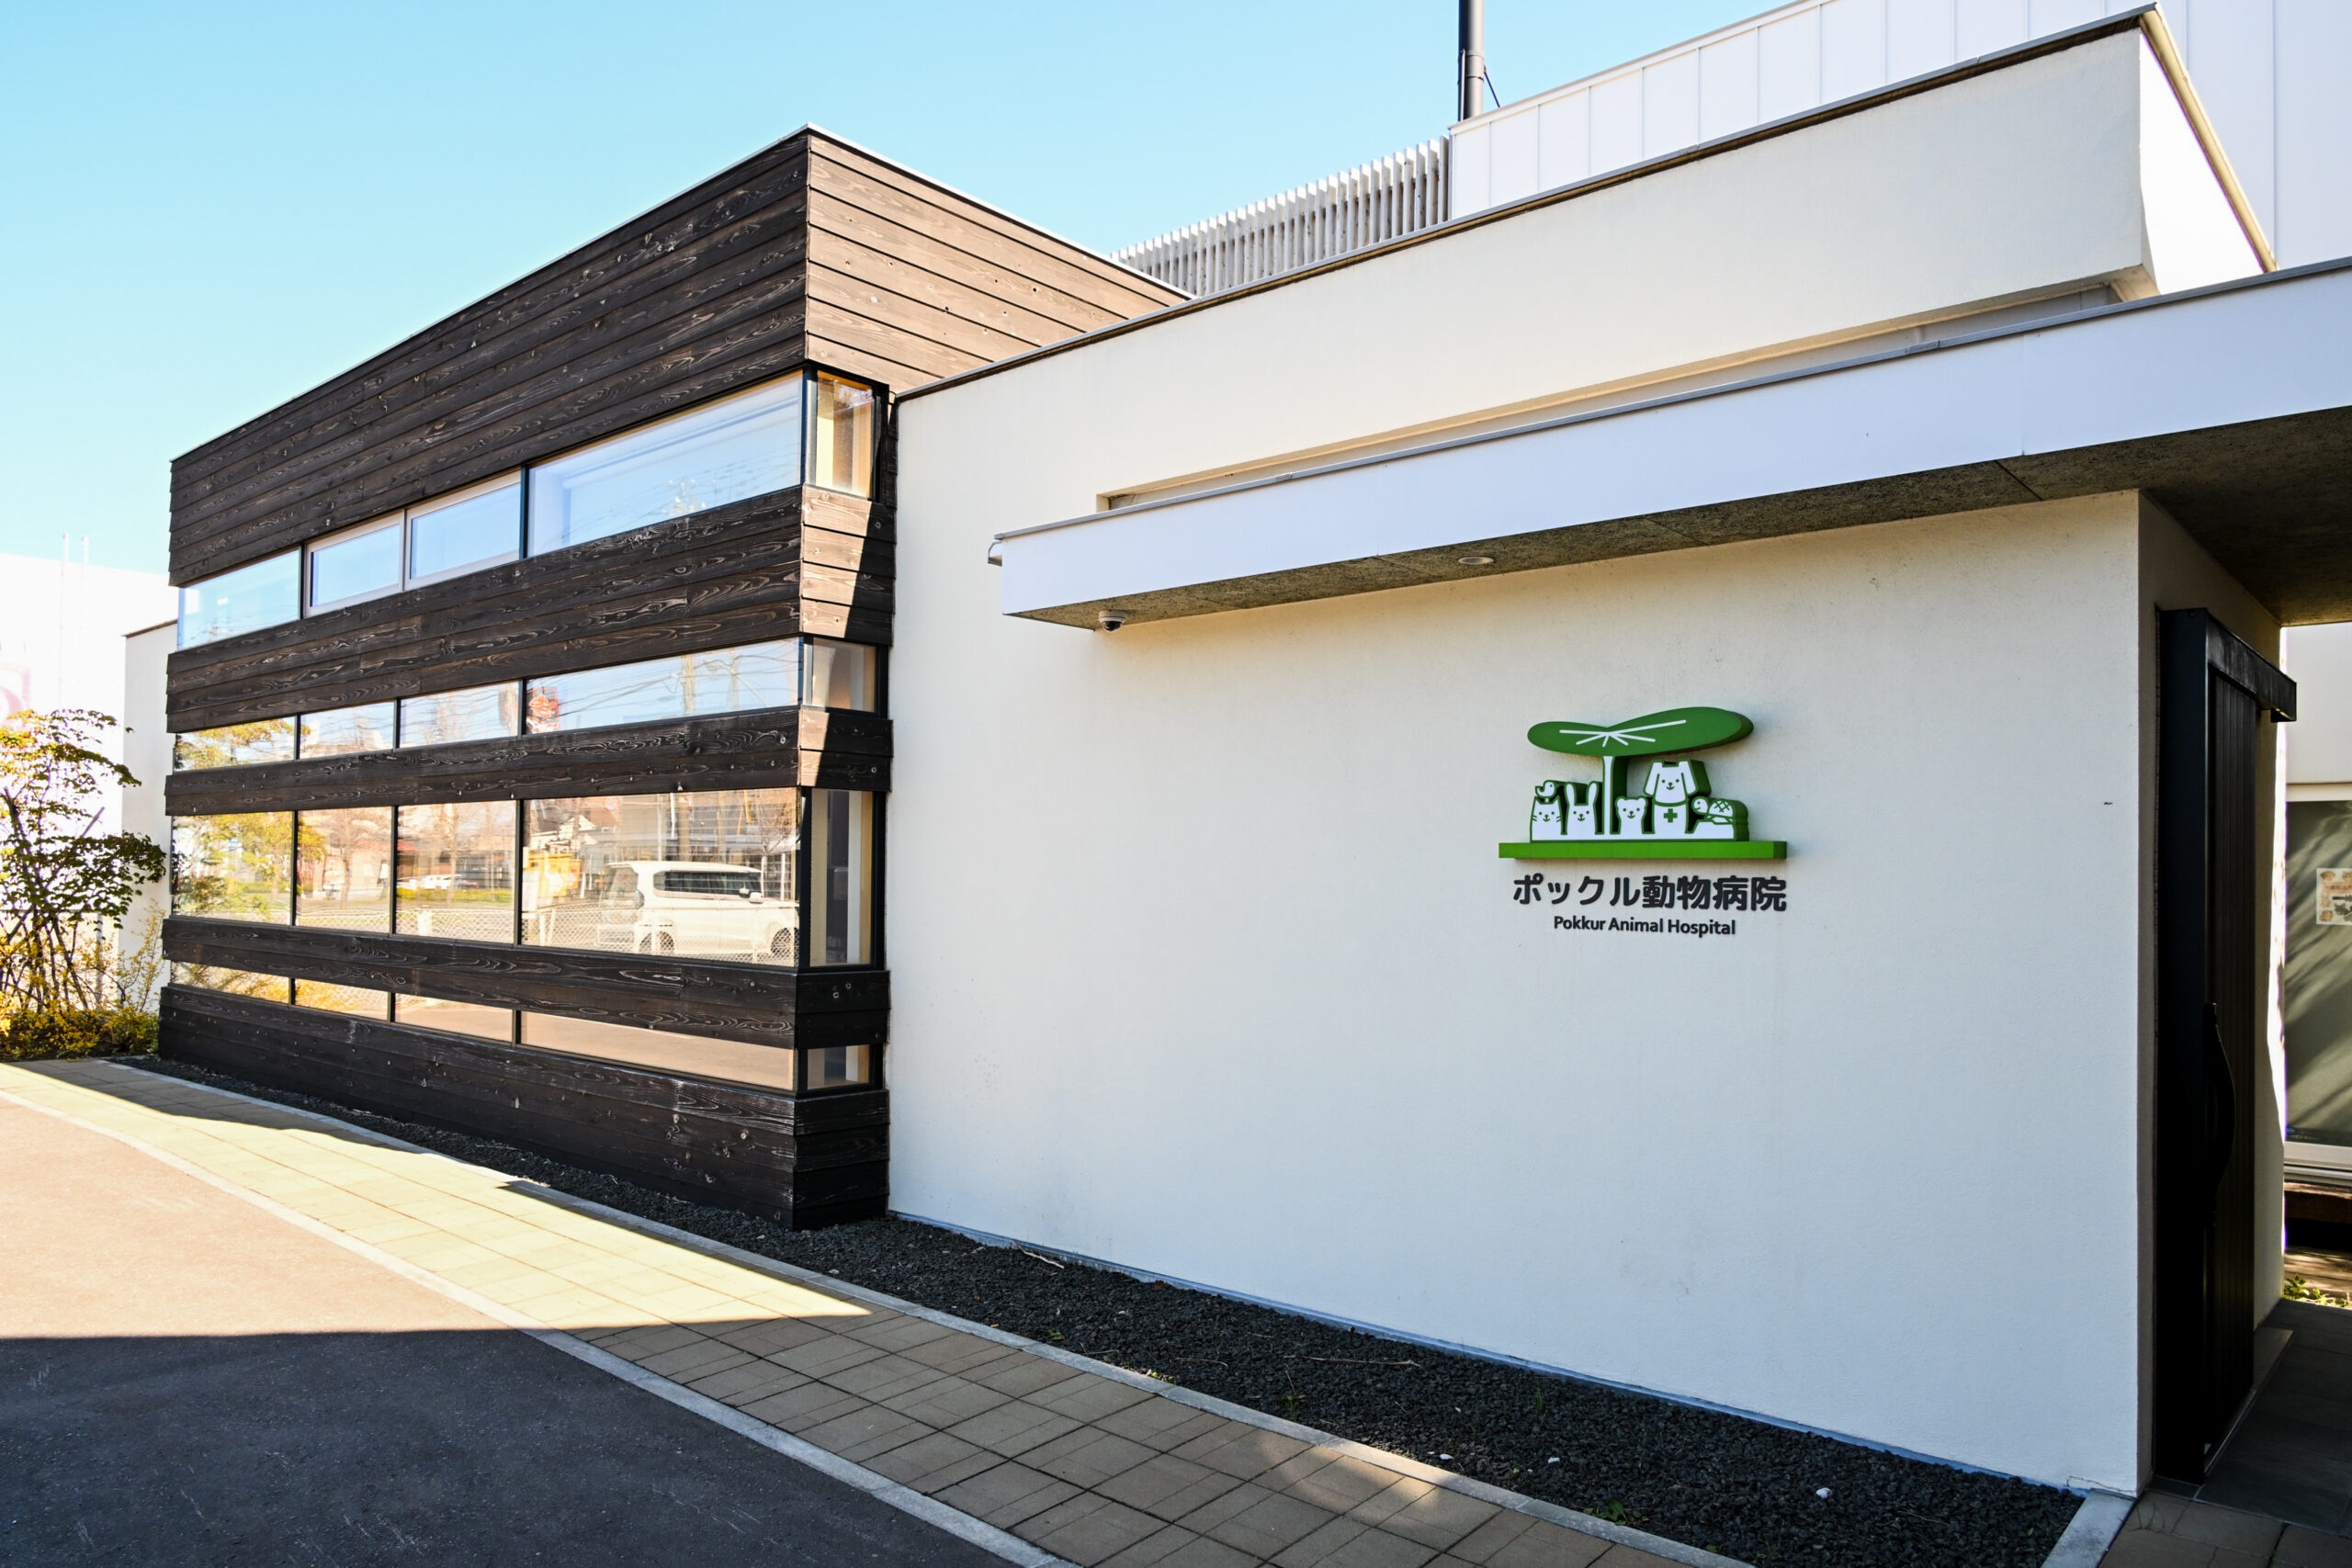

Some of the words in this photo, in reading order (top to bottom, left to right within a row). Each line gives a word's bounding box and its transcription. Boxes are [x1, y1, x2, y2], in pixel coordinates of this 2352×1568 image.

[1512, 873, 1787, 911] ポックル動物病院
[1554, 915, 1606, 931] Pokkur
[1608, 917, 1664, 933] Animal
[1668, 919, 1736, 938] Hospital
